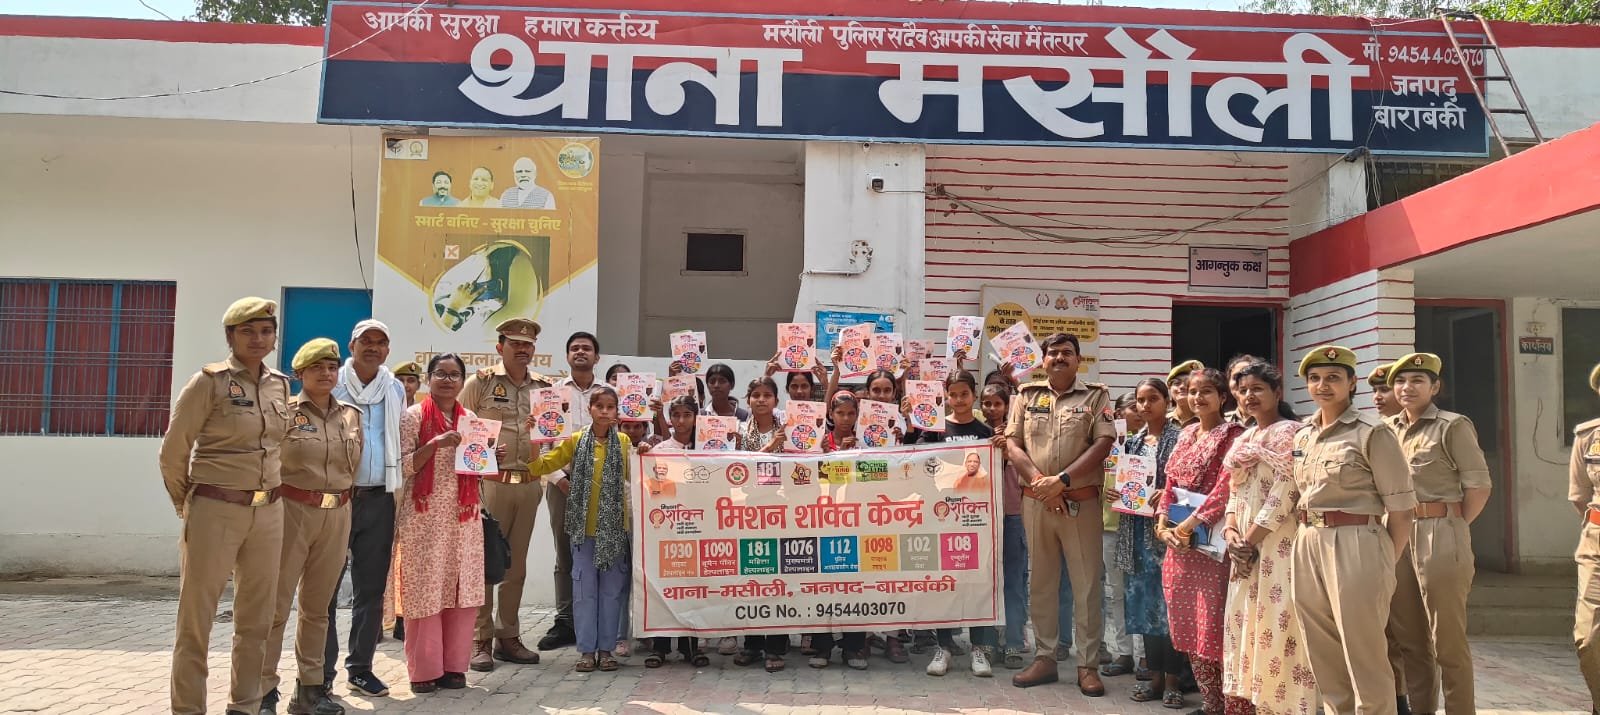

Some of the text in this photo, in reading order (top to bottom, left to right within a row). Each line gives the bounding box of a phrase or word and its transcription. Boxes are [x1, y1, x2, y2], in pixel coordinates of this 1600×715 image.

[362, 8, 434, 32] आपकी
[439, 14, 500, 40] सुरक्षा
[524, 16, 582, 39] हमारा
[762, 19, 1089, 55] मसौली पुलिस सदैव आपकी सेवा में तत्पर
[458, 26, 1370, 142] थाना मसौली
[1390, 75, 1459, 102] जनपद
[1372, 101, 1467, 131] बाराबंकी
[415, 213, 444, 227] स्मार्ट
[446, 213, 480, 229] बनिए
[490, 217, 525, 233] सुरक्षा
[528, 216, 562, 233] चुनिए
[1195, 259, 1262, 277] आगन्तुक कक्ष
[993, 308, 1011, 316] POSH
[716, 495, 925, 530] मिशन शक्ति केन्द्र
[664, 543, 693, 559] 1930
[703, 542, 733, 558] 1090
[748, 541, 770, 556] 181
[784, 540, 814, 555] 1076
[829, 539, 851, 554] 112
[864, 537, 894, 553] 1098
[907, 536, 931, 552] 102
[948, 536, 972, 552] 108
[663, 575, 957, 600] थाना-मसौली, जनपद-बाराबंकी
[735, 605, 771, 620] CUG
[776, 605, 801, 618] No.
[816, 602, 906, 617] 9454403070
